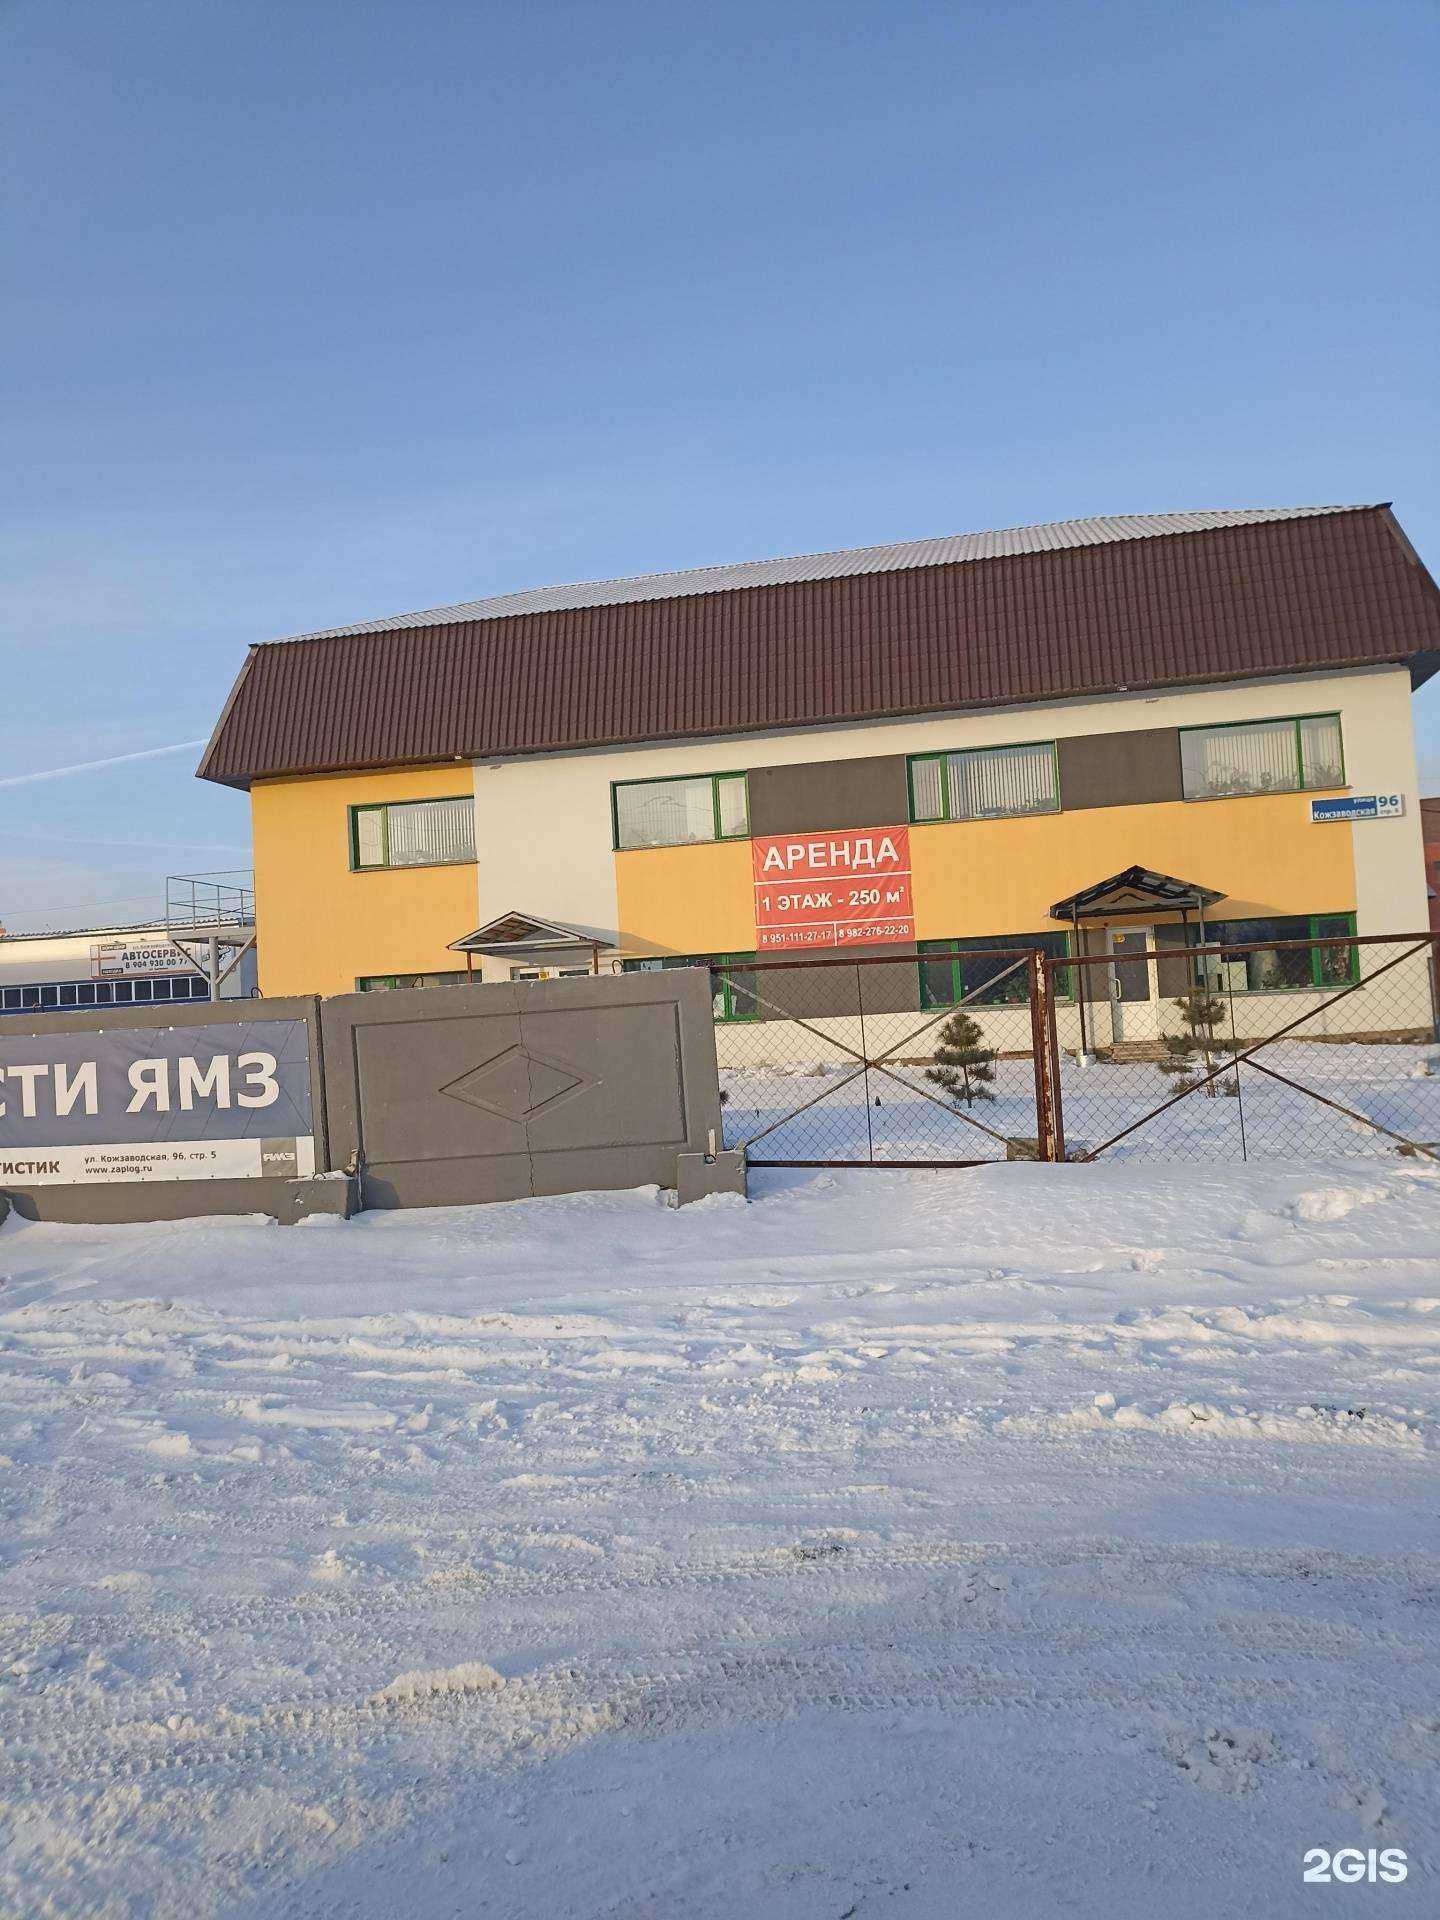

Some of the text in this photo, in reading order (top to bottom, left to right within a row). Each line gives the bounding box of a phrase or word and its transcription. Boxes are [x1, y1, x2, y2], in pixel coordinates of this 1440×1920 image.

[1378, 795, 1399, 807] 96
[1313, 807, 1376, 820] Кожзаводская
[763, 837, 900, 872] АРЕНДА
[762, 897, 771, 912] 1
[777, 892, 833, 911] ЭТАЖ
[848, 889, 880, 906] 250
[762, 930, 832, 944] 8 951-111-27-17
[838, 924, 909, 938] 8 982-276-22-20
[149, 958, 164, 967] 930
[125, 1052, 280, 1113] ЯМЗ
[172, 1152, 187, 1160] 96,
[189, 1151, 208, 1161] стр.
[210, 1150, 217, 1159] 5
[85, 1164, 152, 1174] www.zaplog.ru
